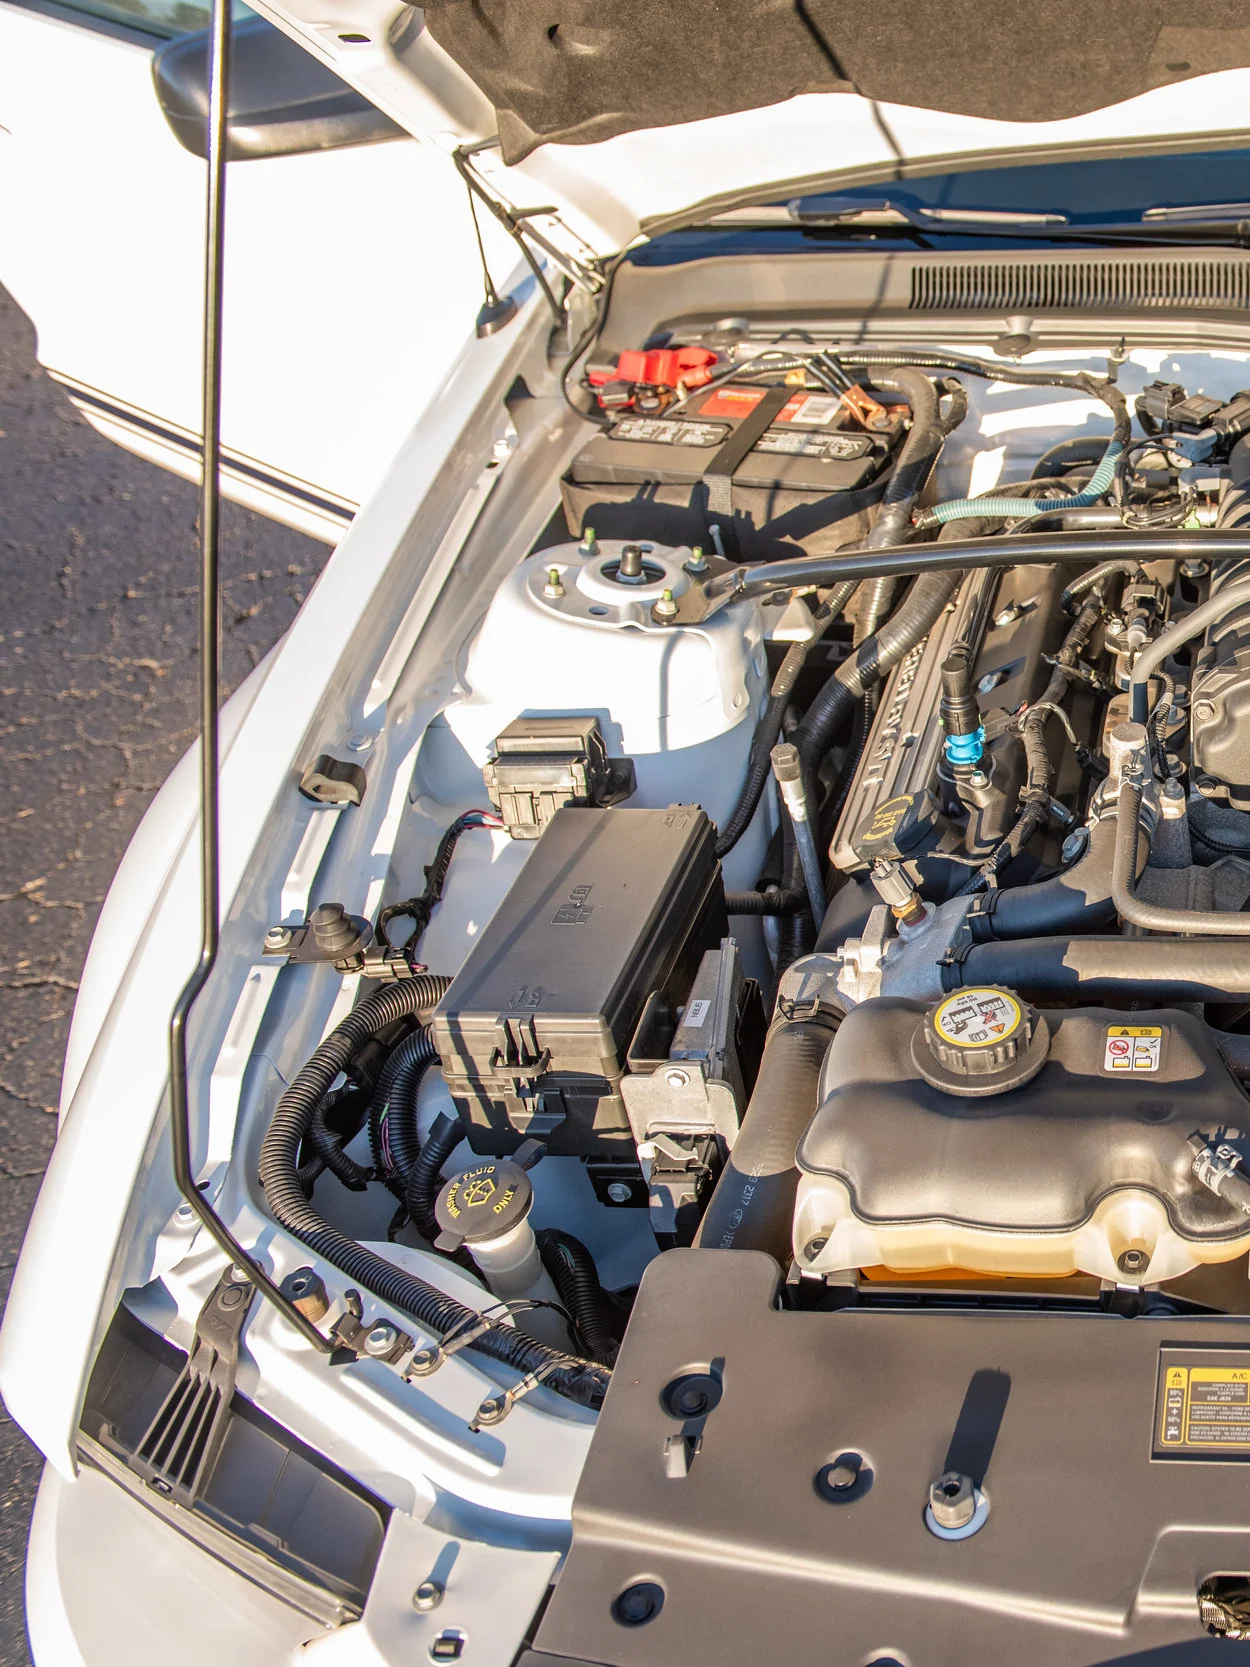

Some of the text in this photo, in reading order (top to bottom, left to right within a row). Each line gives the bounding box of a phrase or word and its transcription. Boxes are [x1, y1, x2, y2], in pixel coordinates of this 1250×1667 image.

[446, 1166, 515, 1220] WASHER FLUID ONLY
[1231, 1372, 1248, 1380] A/C
